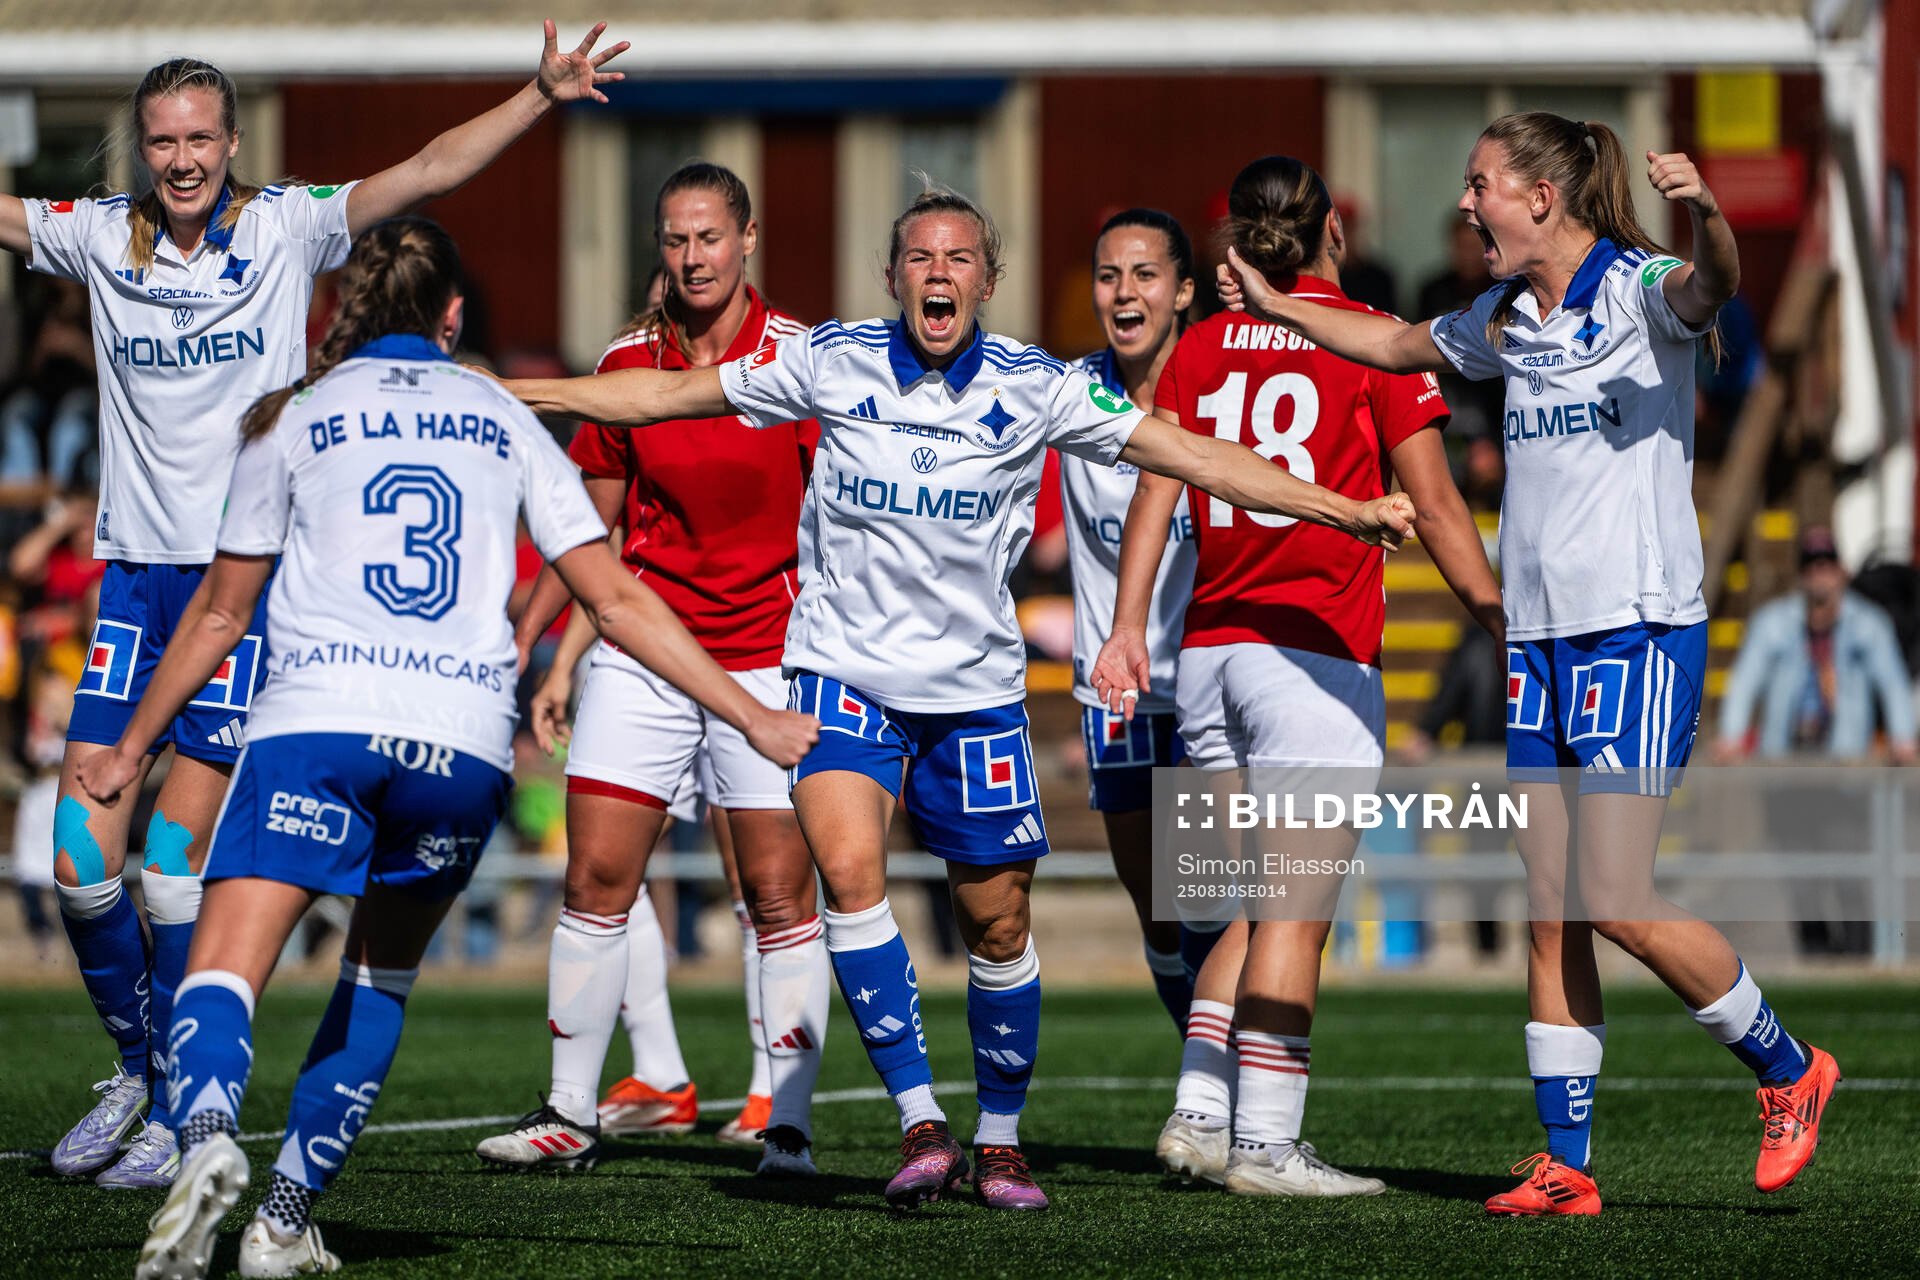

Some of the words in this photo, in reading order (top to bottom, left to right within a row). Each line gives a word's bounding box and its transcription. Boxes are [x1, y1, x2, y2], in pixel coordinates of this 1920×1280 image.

[113, 327, 265, 368] HOLMEN
[740, 369, 751, 390] SPEL
[309, 414, 347, 454] DE
[360, 411, 403, 440] LA
[416, 412, 512, 460] HARPE
[1504, 398, 1622, 442] OLMEN
[1196, 371, 1320, 528] 18
[836, 471, 1002, 521] HOLMEN
[363, 463, 462, 622] 3
[281, 640, 503, 693] PLATINUMCARS
[365, 734, 458, 778] ROR
[270, 790, 321, 818] pre
[265, 812, 332, 844] zero
